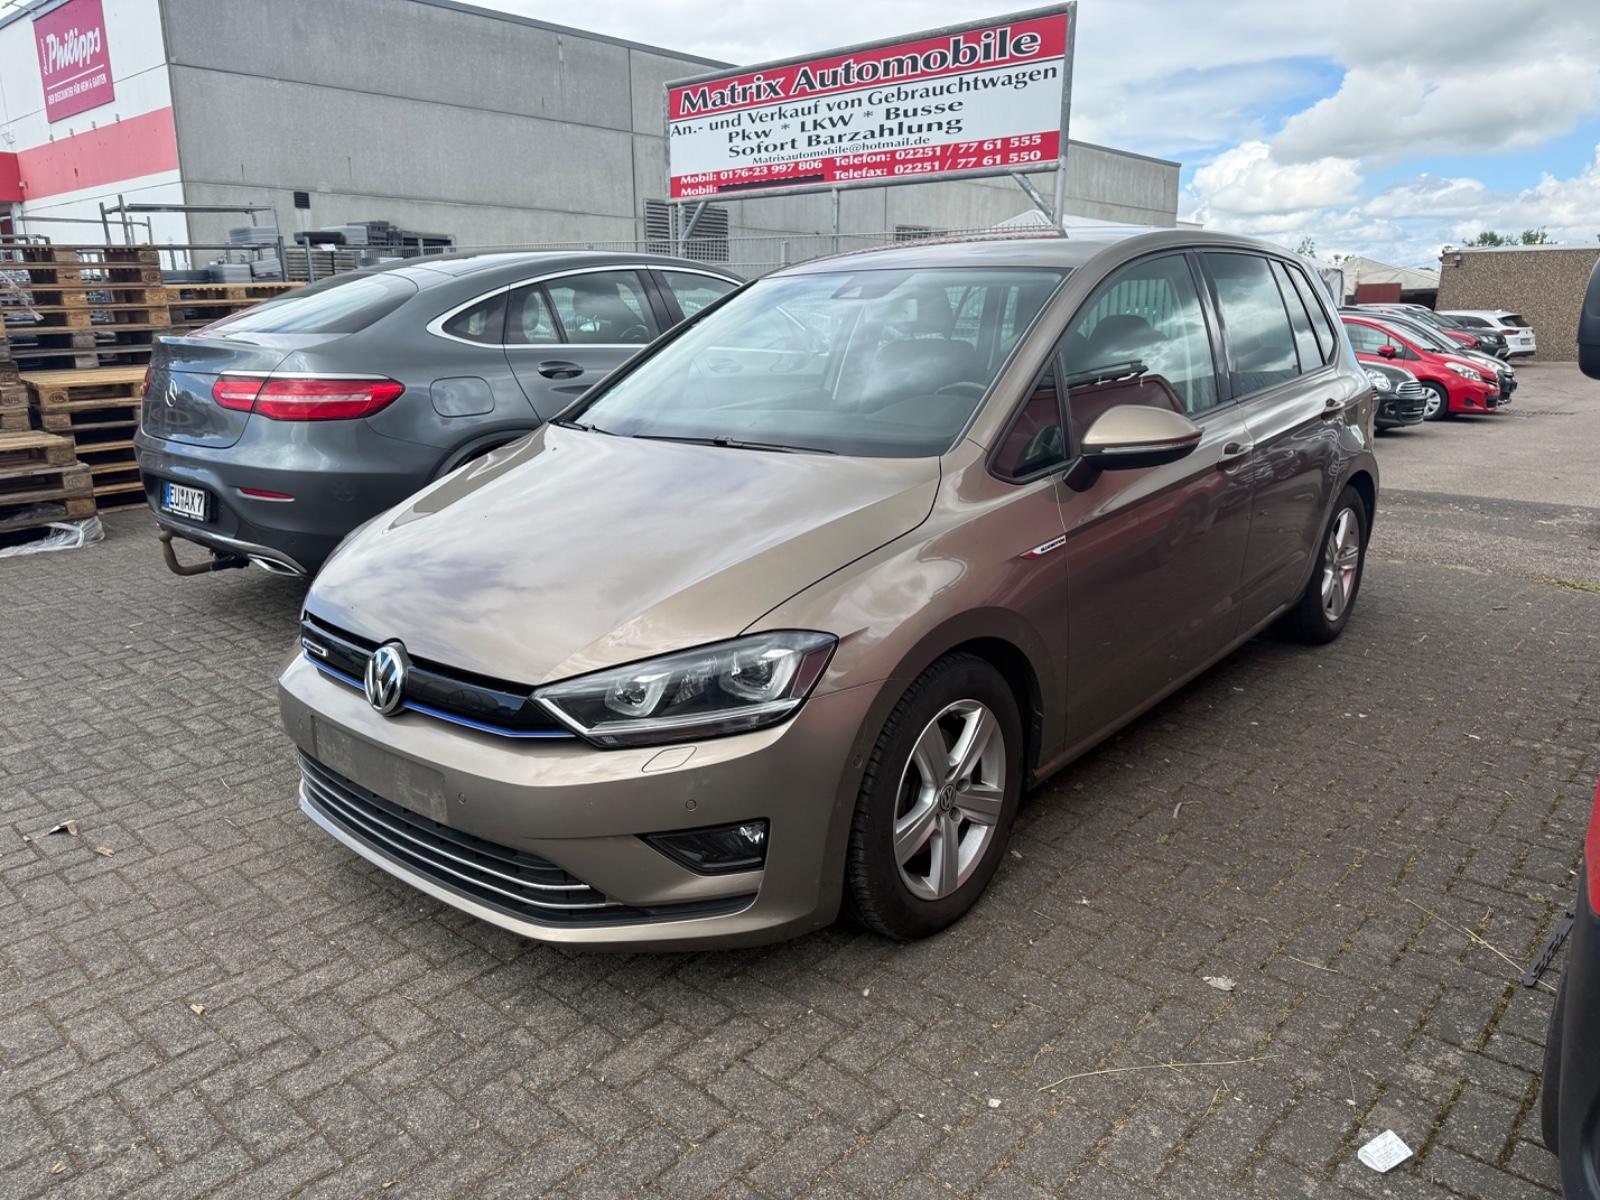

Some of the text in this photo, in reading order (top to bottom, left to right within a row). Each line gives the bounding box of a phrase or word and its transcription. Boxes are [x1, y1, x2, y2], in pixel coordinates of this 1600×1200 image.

[46, 27, 101, 74] Philipps
[680, 26, 1041, 115] Matrix Automobile
[709, 114, 741, 131] und
[748, 101, 820, 124] Verkauf
[826, 96, 863, 112] von
[868, 66, 1057, 106] Gebrauchtwagen
[728, 101, 964, 143] Pkw LKW Busse
[680, 173, 717, 185] Mobil:
[720, 167, 768, 180] 0176-23
[771, 163, 794, 174] 997
[798, 160, 823, 170] 806
[834, 152, 891, 167] Telefon:
[895, 146, 942, 161] 02251
[959, 141, 978, 153] 77
[982, 139, 1002, 151] 61
[1009, 135, 1042, 148] 555
[729, 118, 964, 158] Sofort Barzahlung
[752, 136, 930, 165] Matrixautomobile@hotmail.de
[680, 186, 718, 197] Mobil:
[833, 167, 888, 180] Telefax:
[894, 161, 940, 175] 02251
[957, 156, 976, 168] 77
[982, 155, 1002, 166] 61
[1008, 150, 1042, 163] 550
[170, 485, 180, 507] EU
